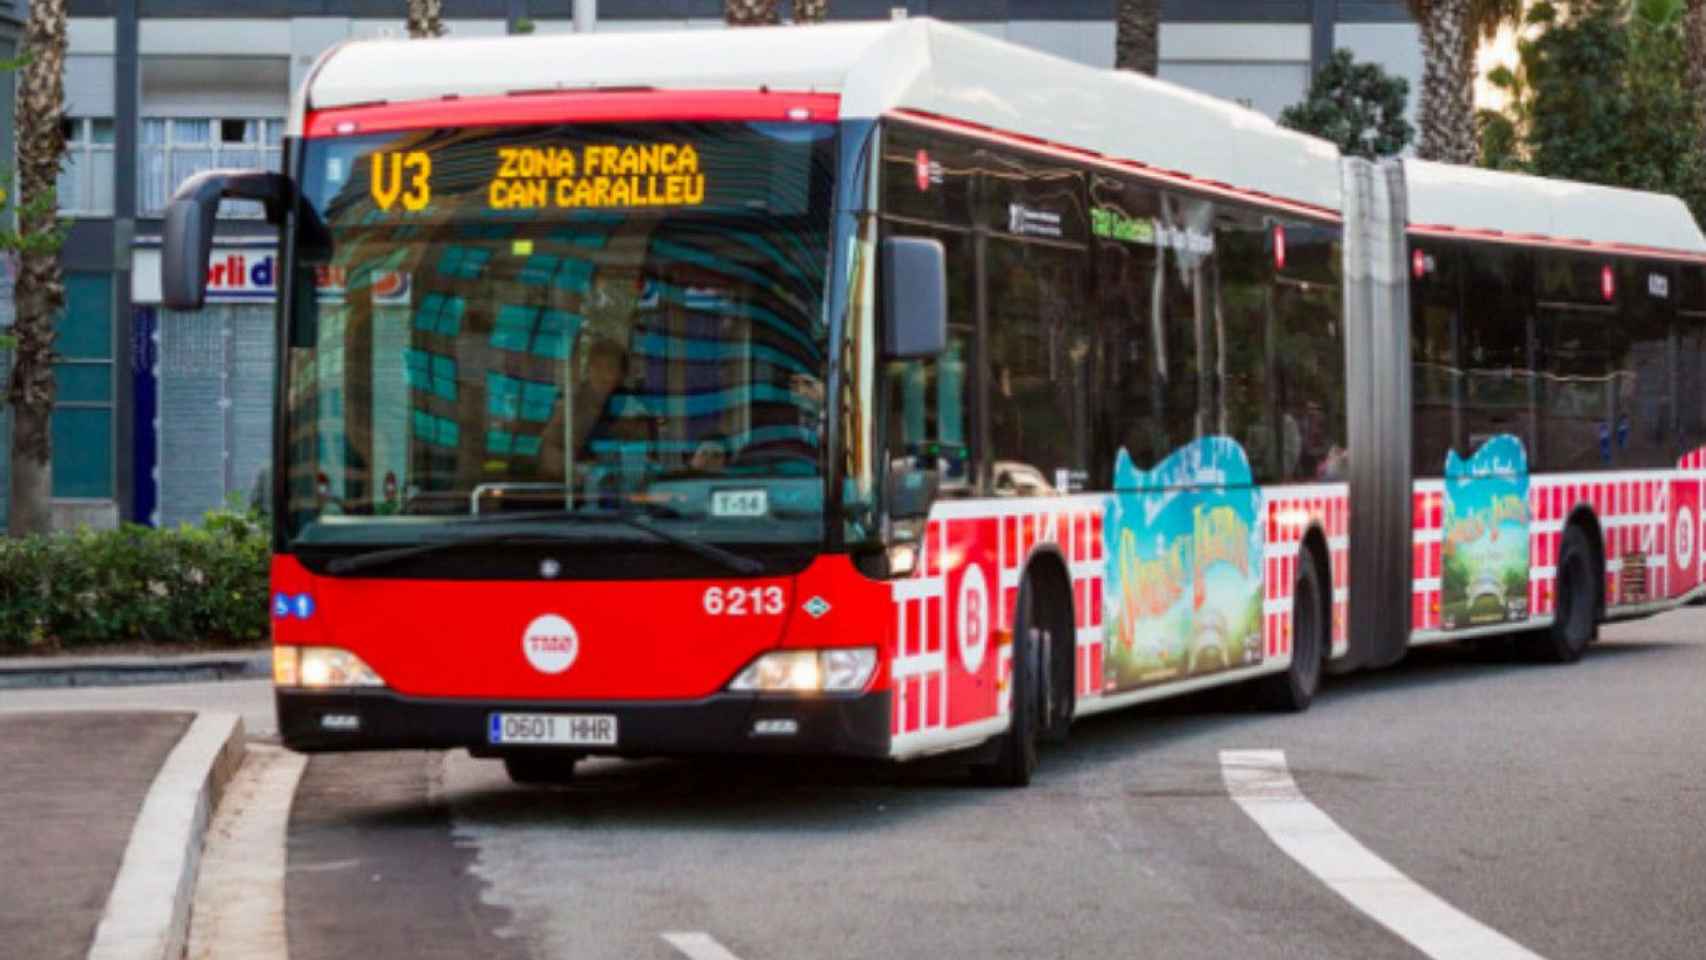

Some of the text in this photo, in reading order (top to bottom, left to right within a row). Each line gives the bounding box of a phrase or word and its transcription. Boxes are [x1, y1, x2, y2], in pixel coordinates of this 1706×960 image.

[498, 144, 697, 178] ZONA FRANCA
[370, 151, 432, 212] V3
[489, 173, 704, 209] CAN CARALLEU
[703, 586, 784, 616] 6213
